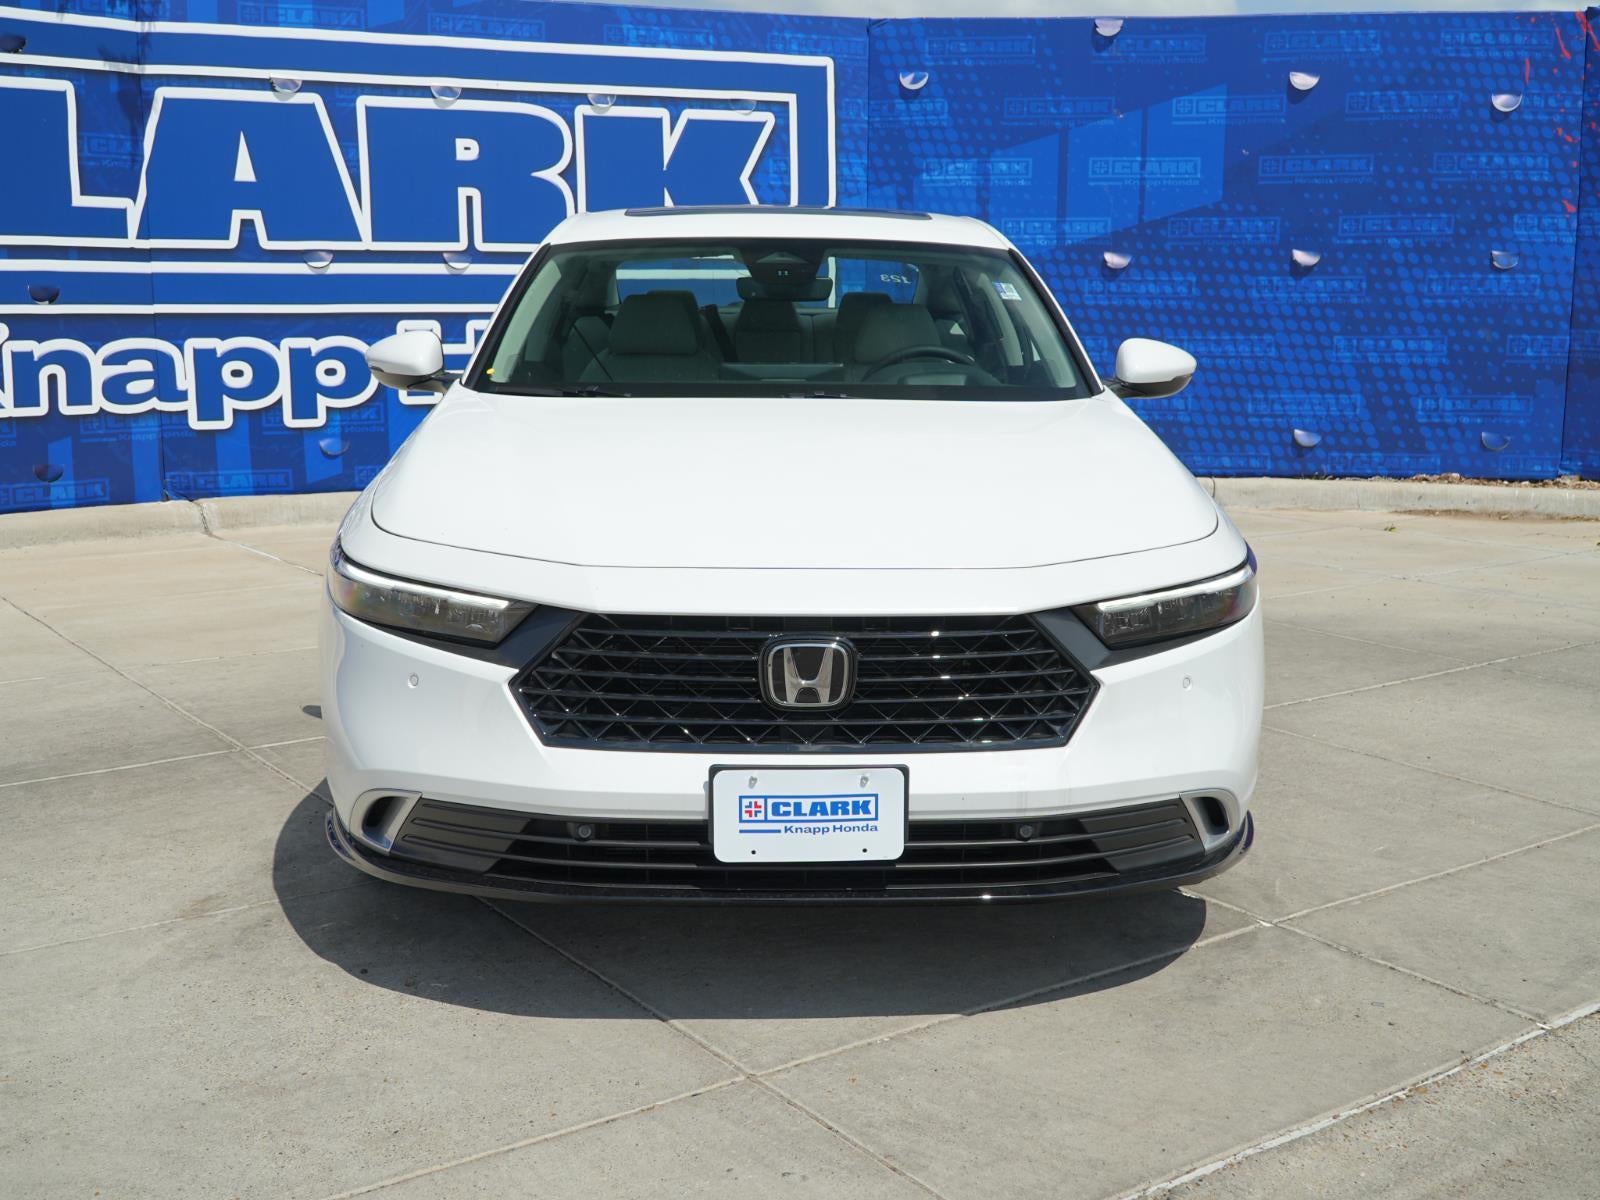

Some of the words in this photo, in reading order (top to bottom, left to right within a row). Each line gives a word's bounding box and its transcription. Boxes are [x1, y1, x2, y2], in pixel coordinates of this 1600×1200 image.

[455, 20, 541, 37] CLARK
[1113, 160, 1195, 174] CLARK
[1286, 158, 1369, 172] CLARK
[0, 322, 378, 430] napp
[197, 472, 290, 489] CLARK
[15, 481, 105, 503] CLARK
[771, 800, 871, 817] CLARK
[784, 825, 830, 835] Knapp
[832, 823, 878, 833] Honda
